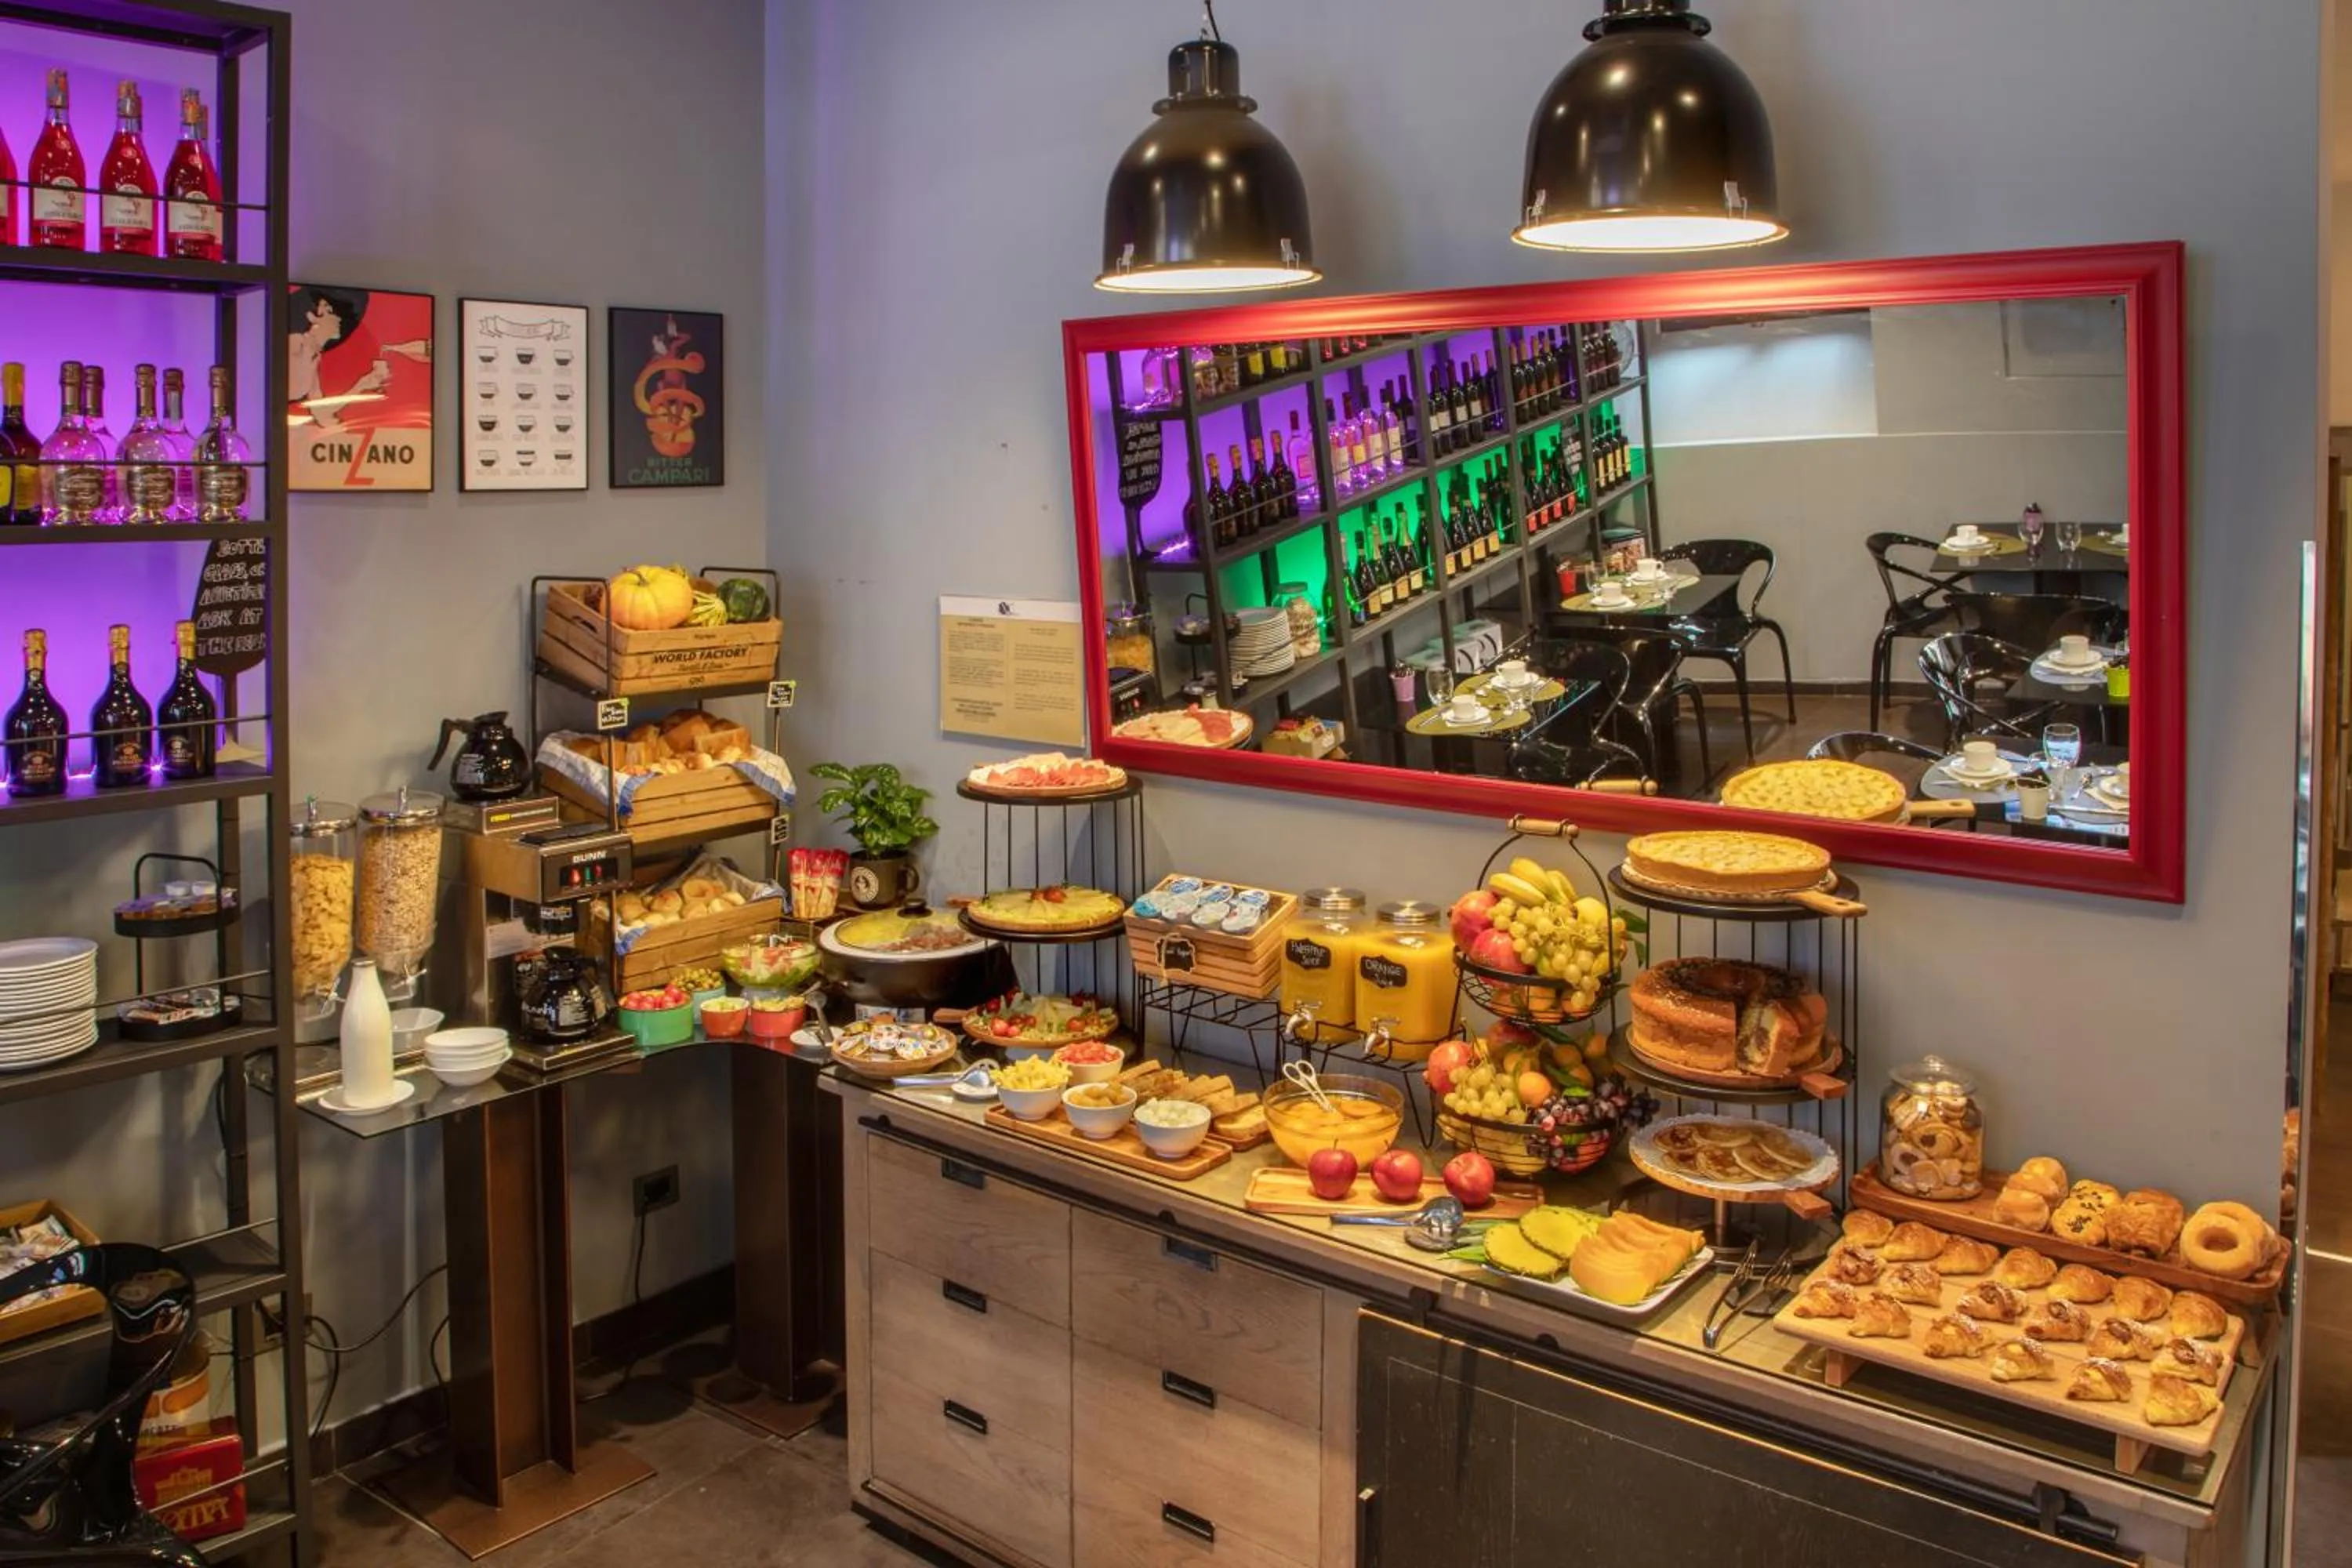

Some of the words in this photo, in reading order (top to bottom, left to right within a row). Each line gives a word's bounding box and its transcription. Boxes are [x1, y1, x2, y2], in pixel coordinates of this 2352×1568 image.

[310, 426, 415, 485] CINZANO
[628, 467, 710, 484] CAMPARI
[238, 607, 263, 625] AT
[653, 652, 697, 664] WORLD
[699, 648, 748, 661] FACTORY
[572, 851, 608, 863] BUNN
[1365, 959, 1403, 977] ORANGE
